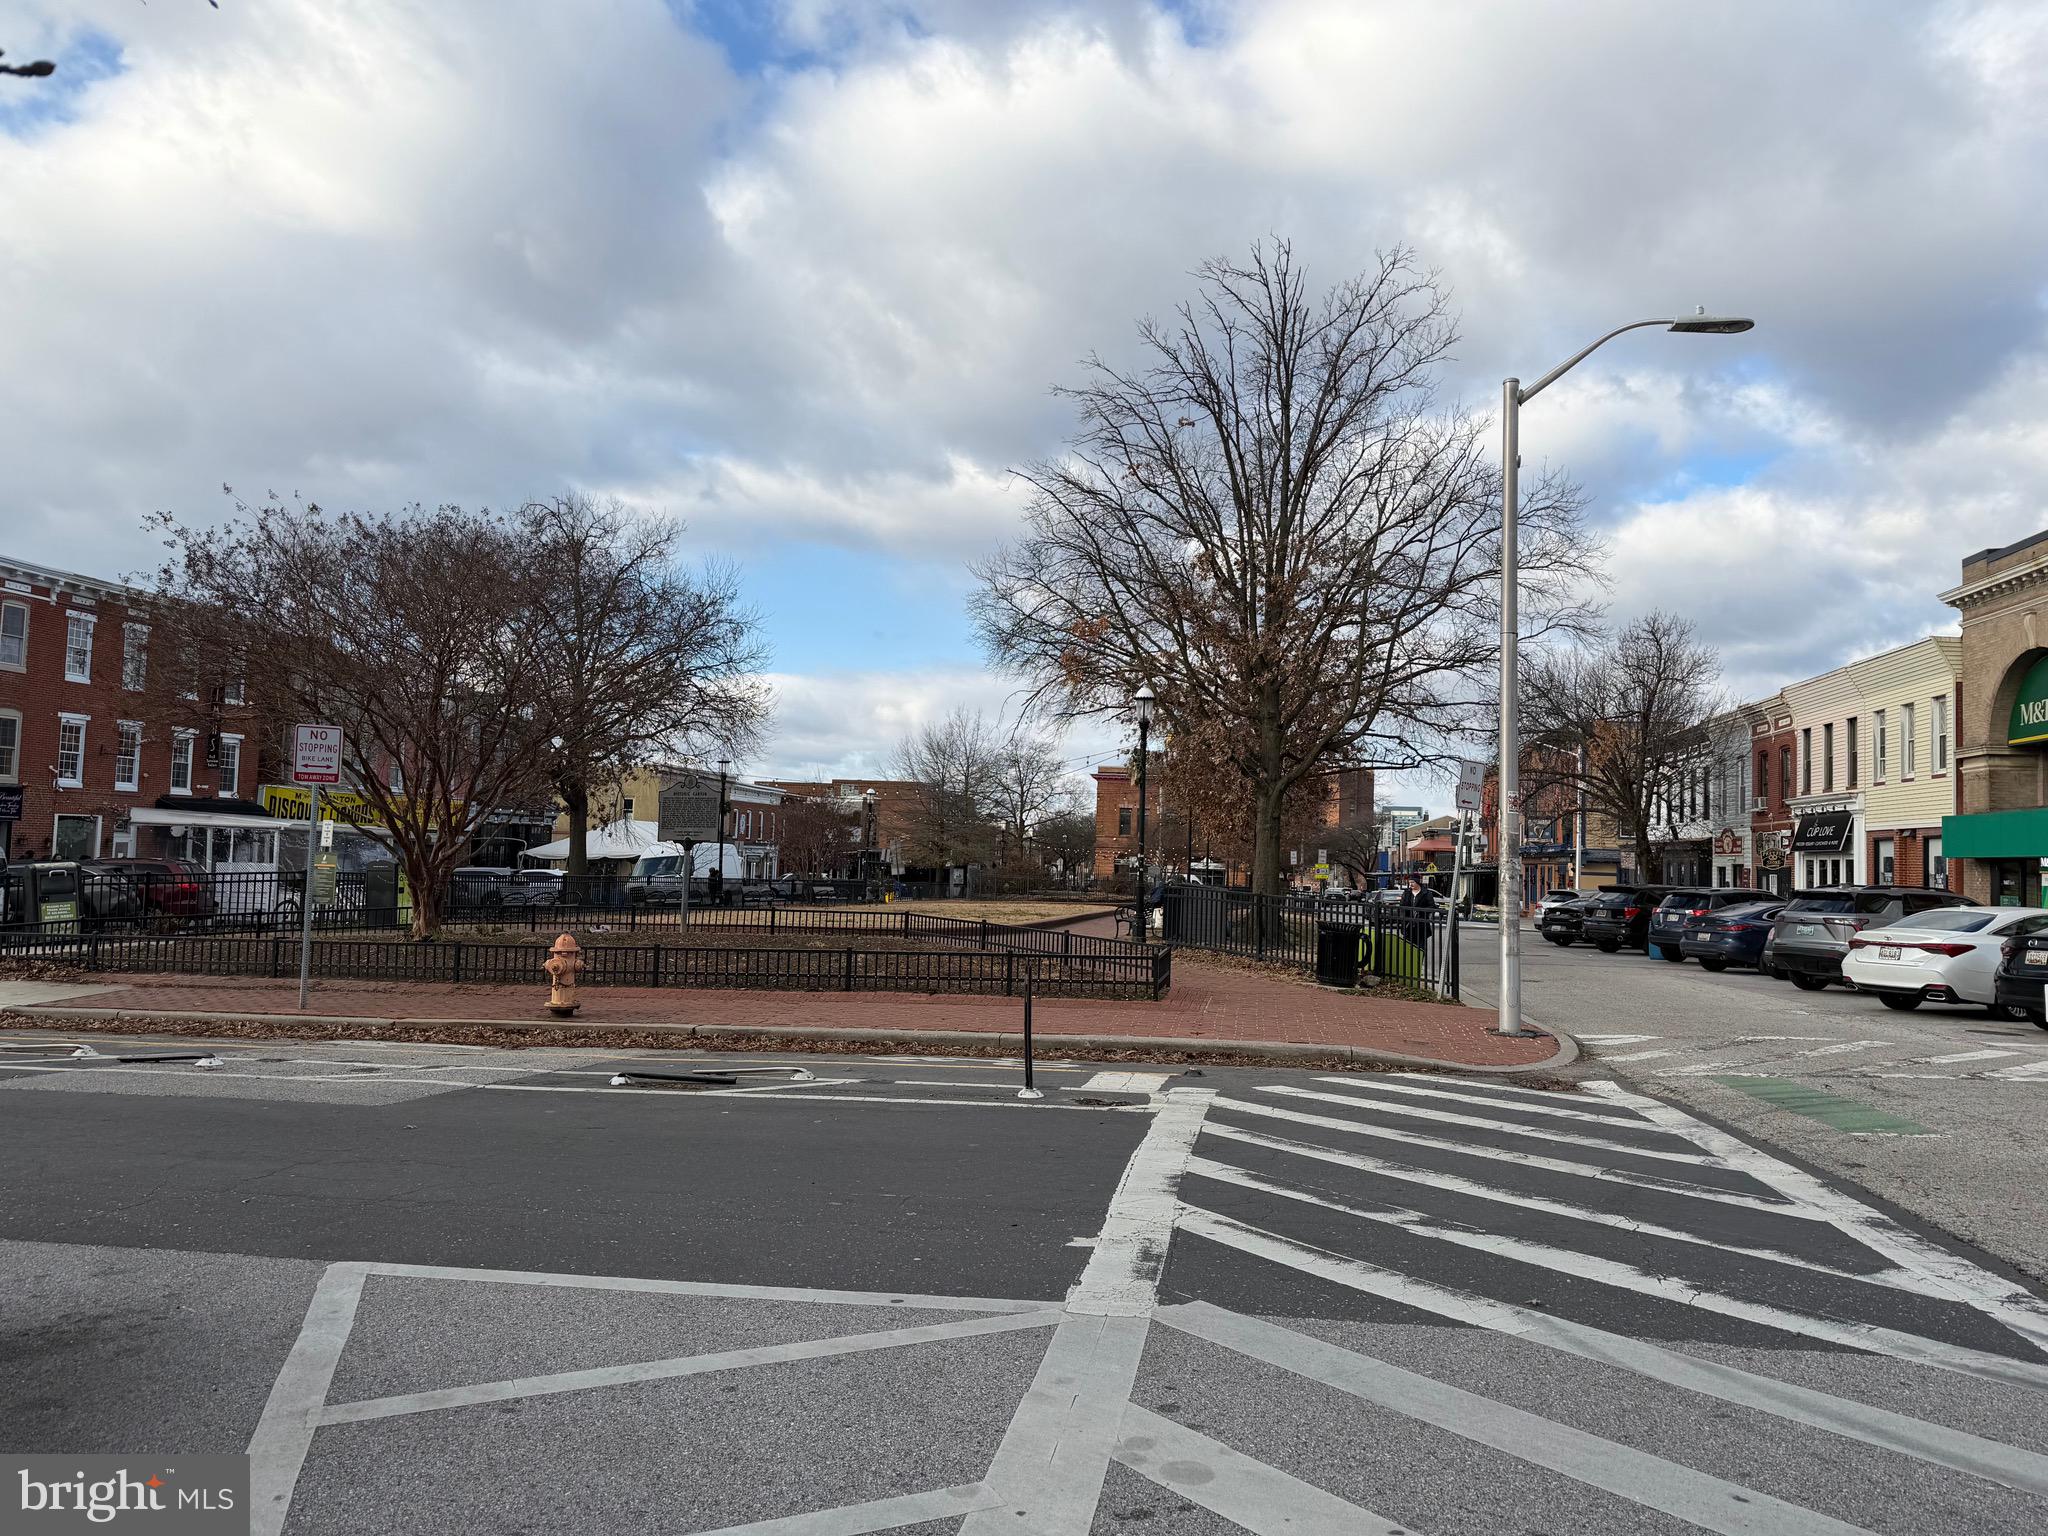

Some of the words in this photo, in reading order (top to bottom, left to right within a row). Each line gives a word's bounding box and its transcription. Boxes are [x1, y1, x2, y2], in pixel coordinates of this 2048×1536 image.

[310, 730, 328, 740] NO
[299, 743, 338, 753] STOPPING
[1470, 766, 1477, 775] NO
[1460, 781, 1481, 792] STOPPING
[269, 795, 327, 822] DISCOUT
[1806, 826, 1820, 838] CUP
[1818, 825, 1836, 837] LOVE
